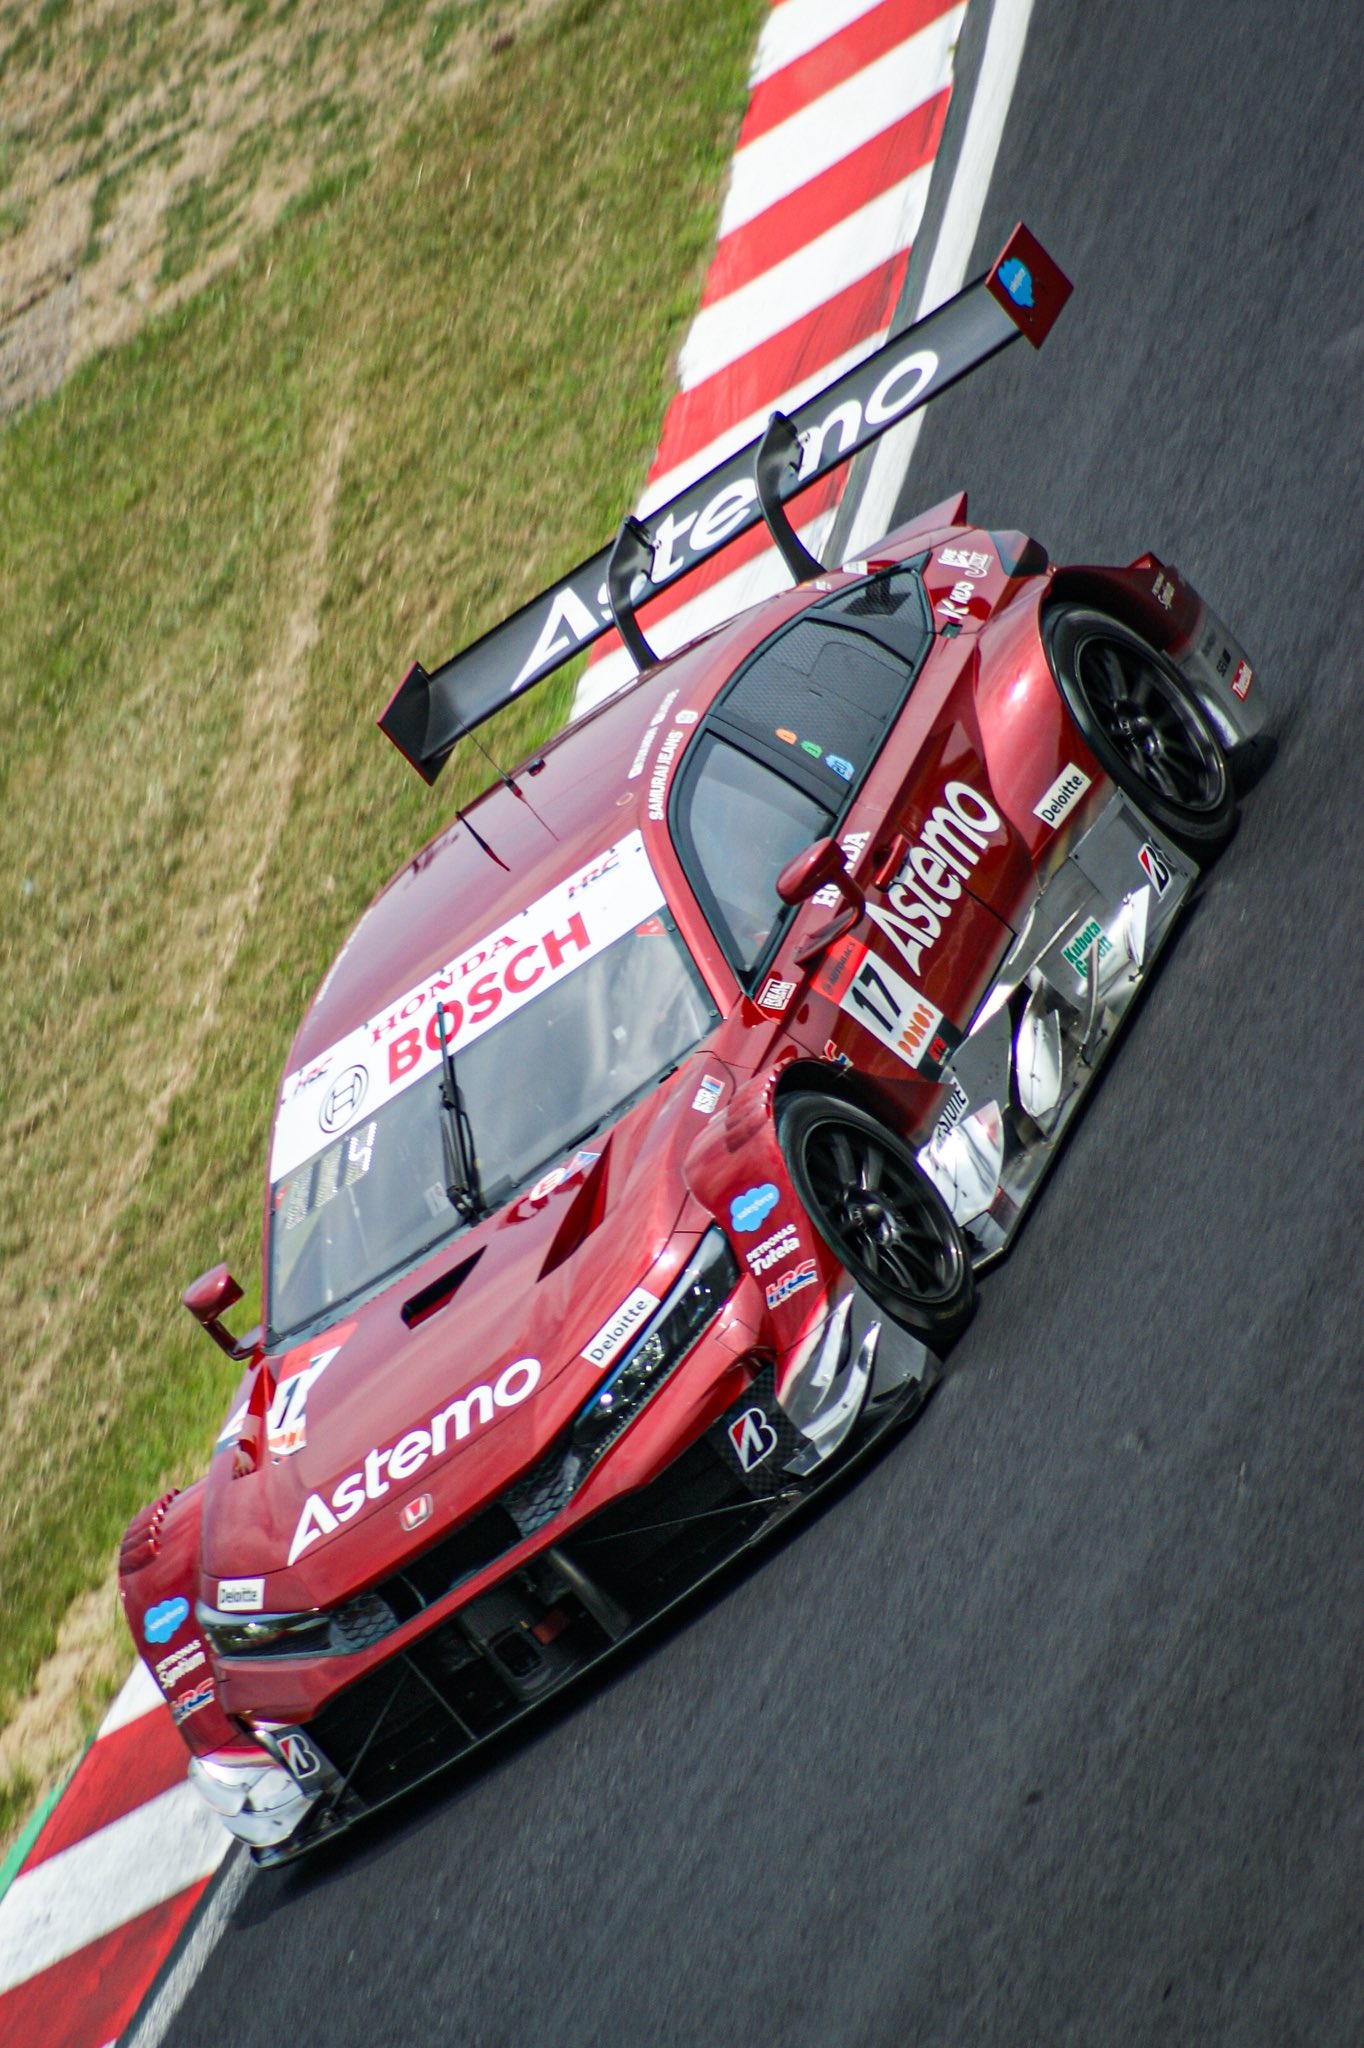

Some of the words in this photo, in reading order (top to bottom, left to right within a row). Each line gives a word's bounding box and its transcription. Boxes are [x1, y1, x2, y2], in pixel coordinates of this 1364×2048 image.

[657, 730, 684, 765] JEANS
[648, 765, 671, 821] SAMURAI
[1042, 774, 1083, 823] Deloitte
[865, 780, 1001, 977] Astemo
[1063, 921, 1101, 964] Kubota
[370, 935, 519, 1046] HONDA
[388, 911, 592, 1086] BOSCH
[851, 962, 902, 1034] 17
[897, 1003, 935, 1058] PONOS
[745, 1224, 798, 1263] PETRONAS
[750, 1237, 800, 1276] Tutela
[765, 1258, 817, 1307] HRC
[590, 1299, 648, 1362] Deloitte
[287, 1358, 542, 1567] Astemo
